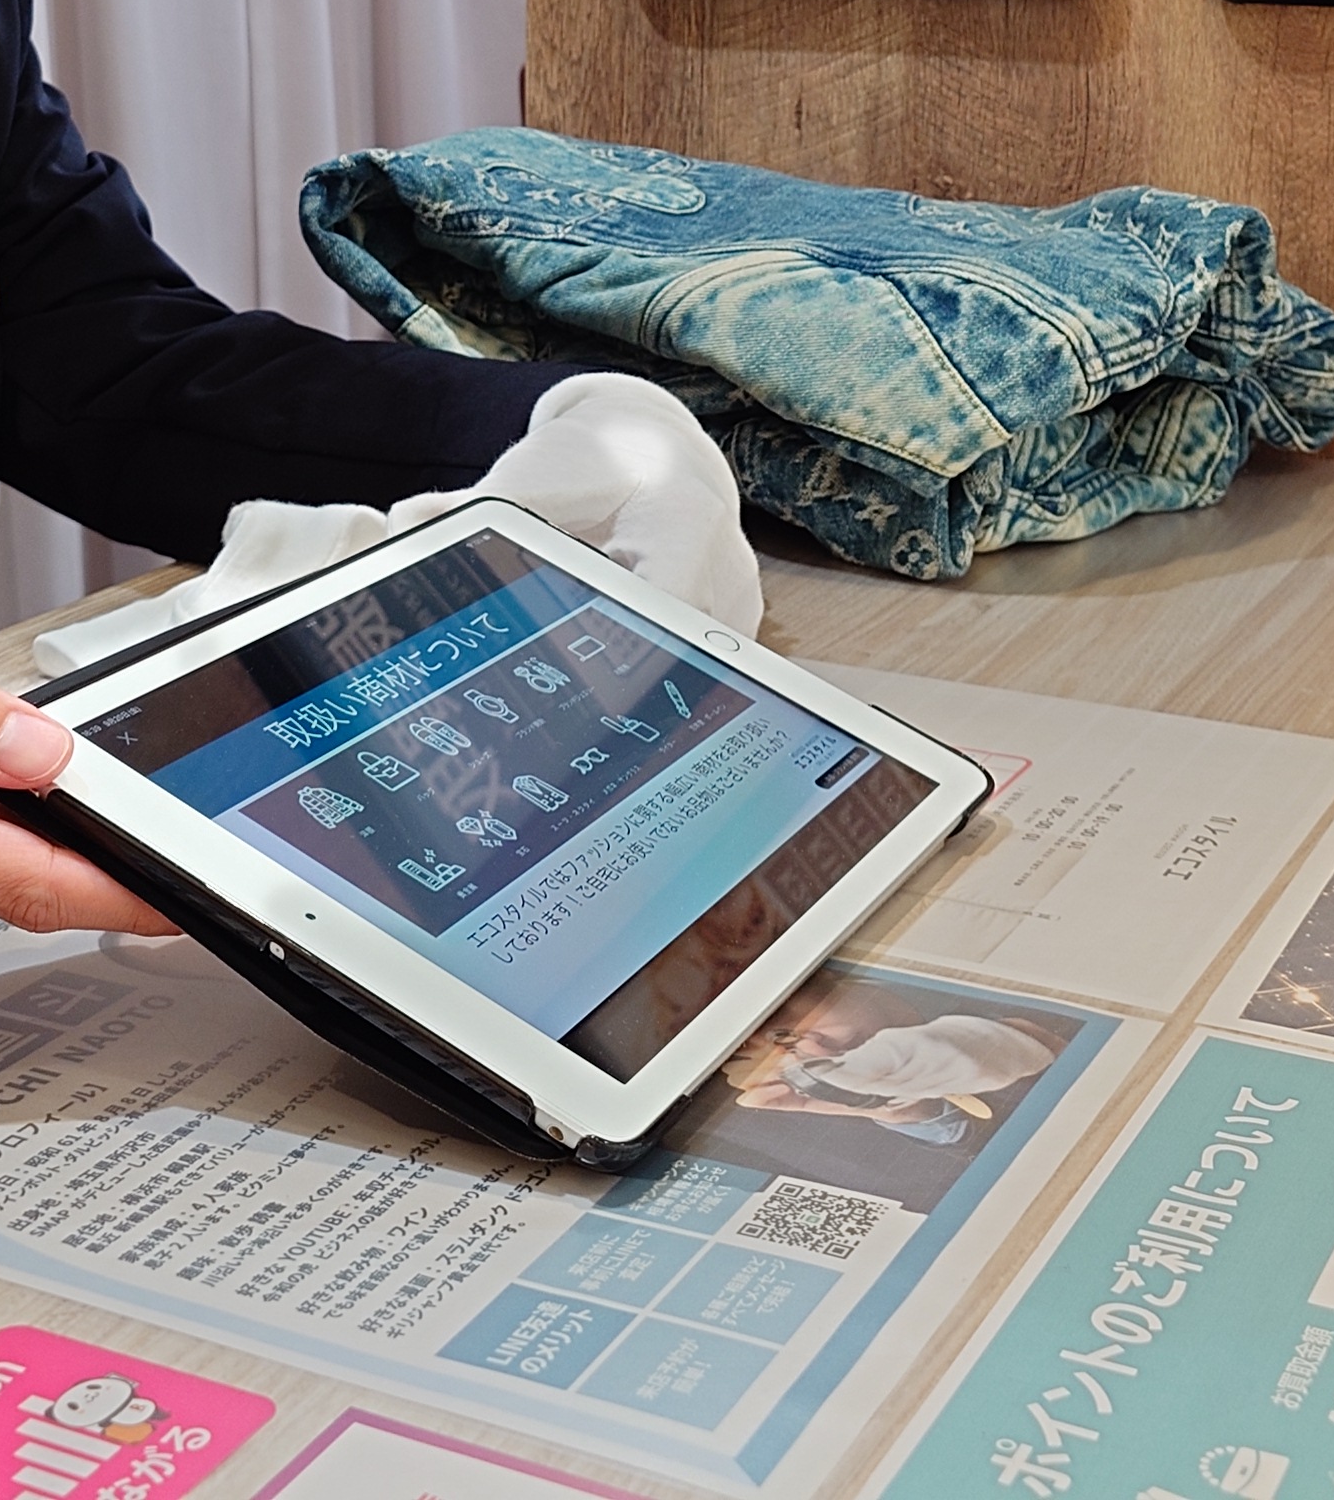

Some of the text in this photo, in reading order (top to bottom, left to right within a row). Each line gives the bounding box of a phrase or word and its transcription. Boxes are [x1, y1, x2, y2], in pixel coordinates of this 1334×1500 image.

[259, 607, 518, 753] 取扱い商材について
[1163, 814, 1238, 881] エコスタイル
[52, 993, 180, 1063] NAOTO
[2, 1130, 162, 1231] 出身地：埼玉県所沢市
[291, 1205, 438, 1315] 好きな飲み物：ワイン
[989, 1085, 1300, 1499] ポイントのご利用について
[483, 1300, 567, 1365] LINE友達
[514, 1306, 600, 1373] のメリット
